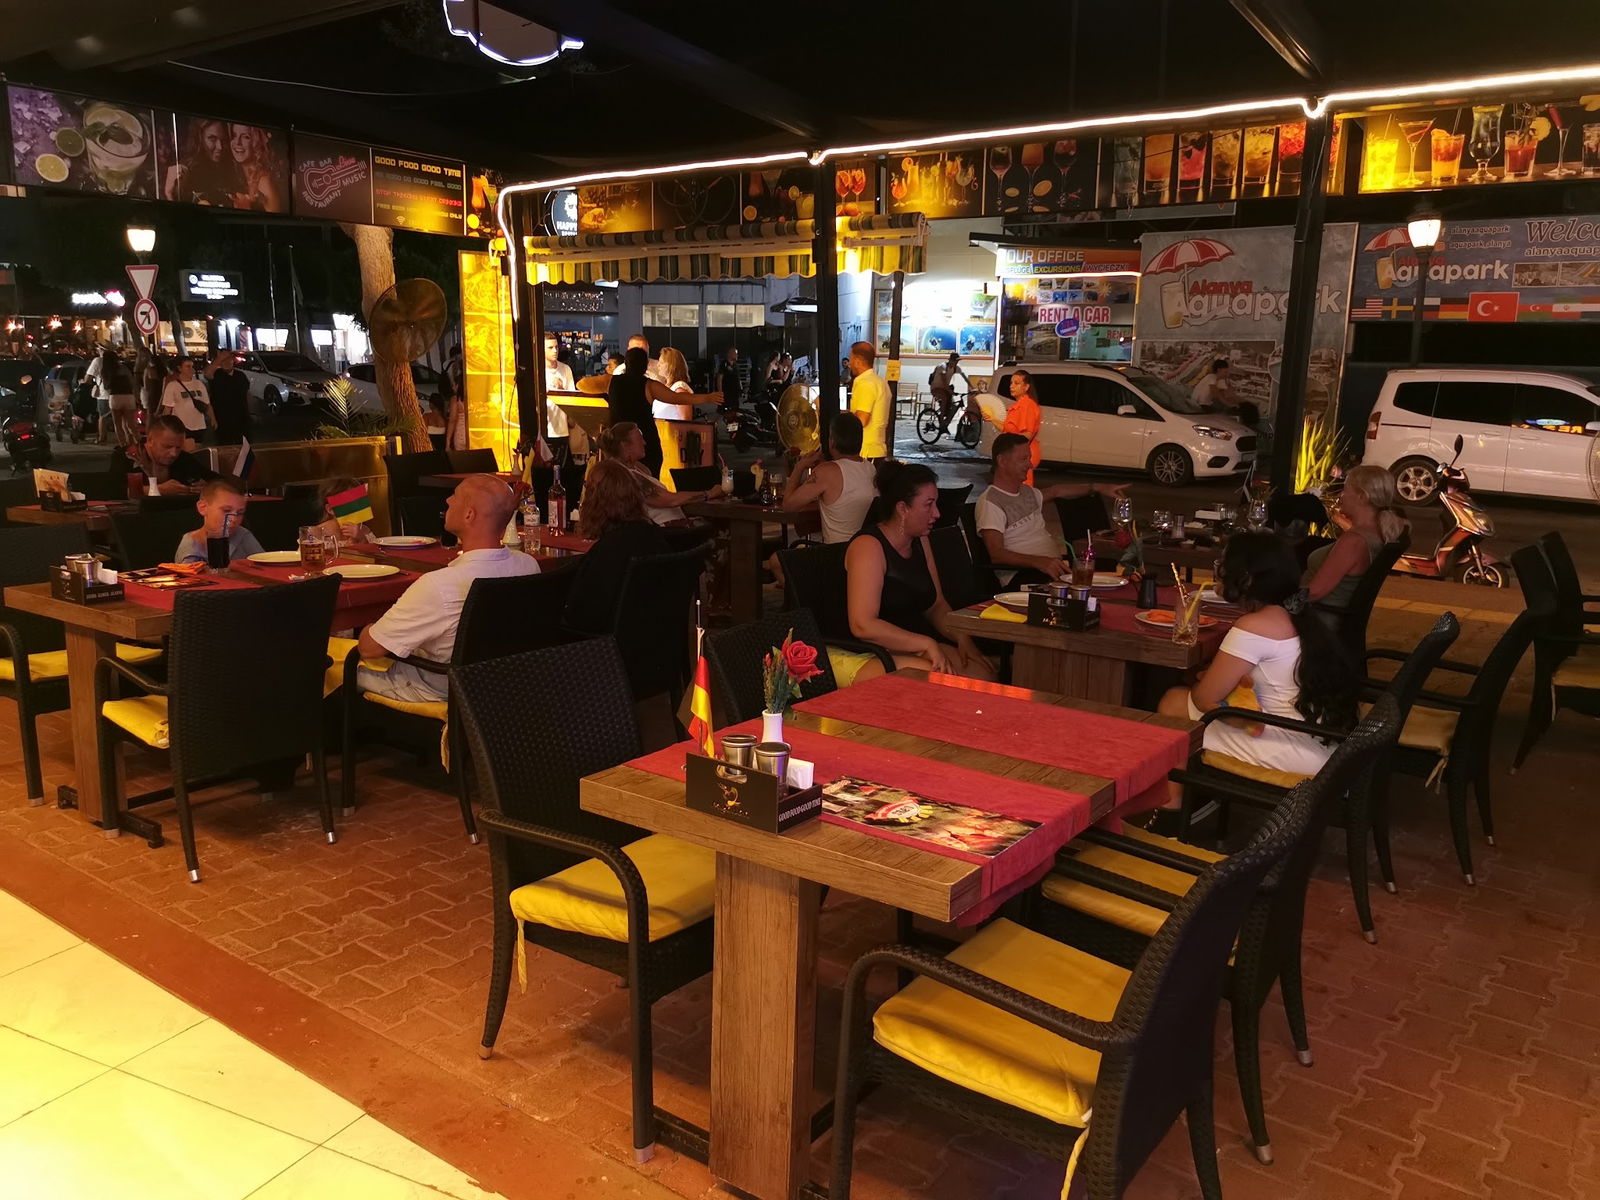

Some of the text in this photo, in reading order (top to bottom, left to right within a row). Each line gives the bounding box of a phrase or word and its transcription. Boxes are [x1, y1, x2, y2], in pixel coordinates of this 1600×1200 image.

[375, 156, 462, 178] GOOD FOOD GOOD TIME
[342, 171, 367, 187] MUSIC
[301, 189, 341, 208] RESTAURANT
[1006, 249, 1084, 264] OUR OFFICE
[1034, 265, 1081, 274] EXCURSIONS
[1188, 279, 1253, 295] Alanya
[1040, 307, 1110, 323] RENT A CAR
